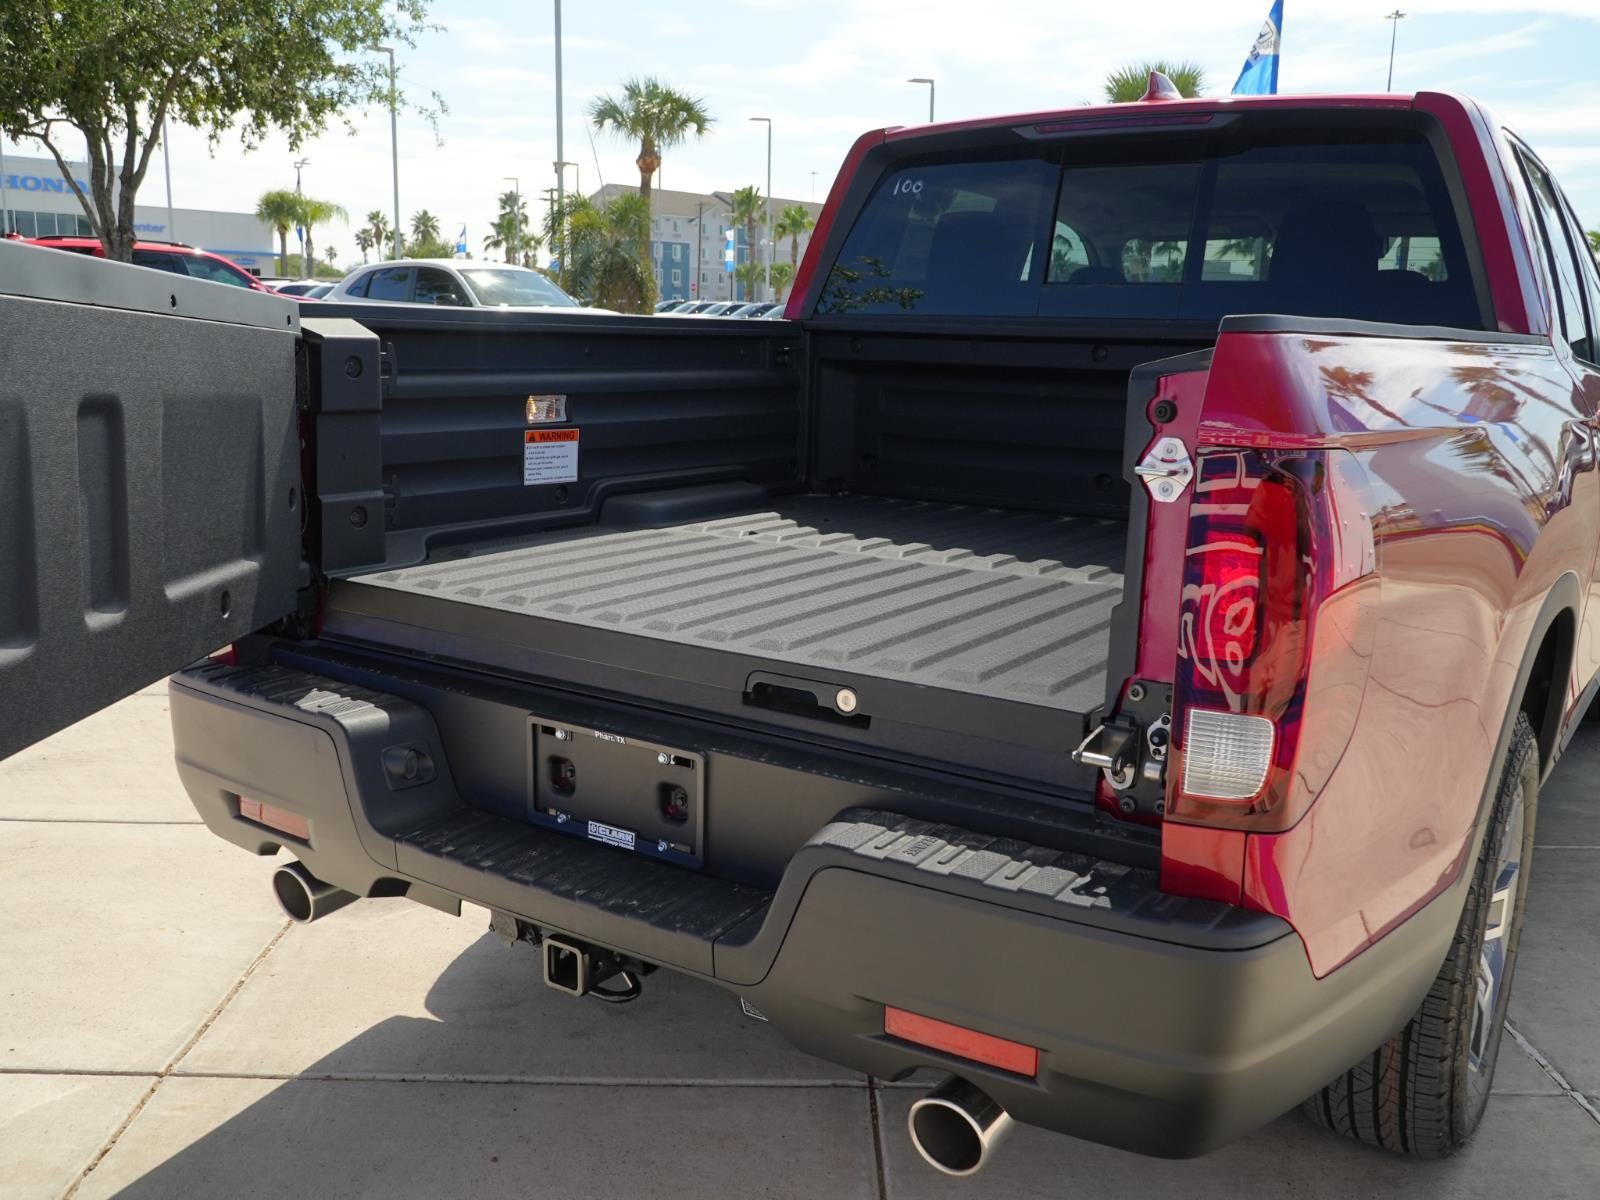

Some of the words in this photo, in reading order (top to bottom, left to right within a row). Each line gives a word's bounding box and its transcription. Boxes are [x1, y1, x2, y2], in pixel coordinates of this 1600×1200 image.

[893, 177, 922, 195] 100
[539, 431, 575, 441] WARNING
[598, 826, 633, 843] CLARK
